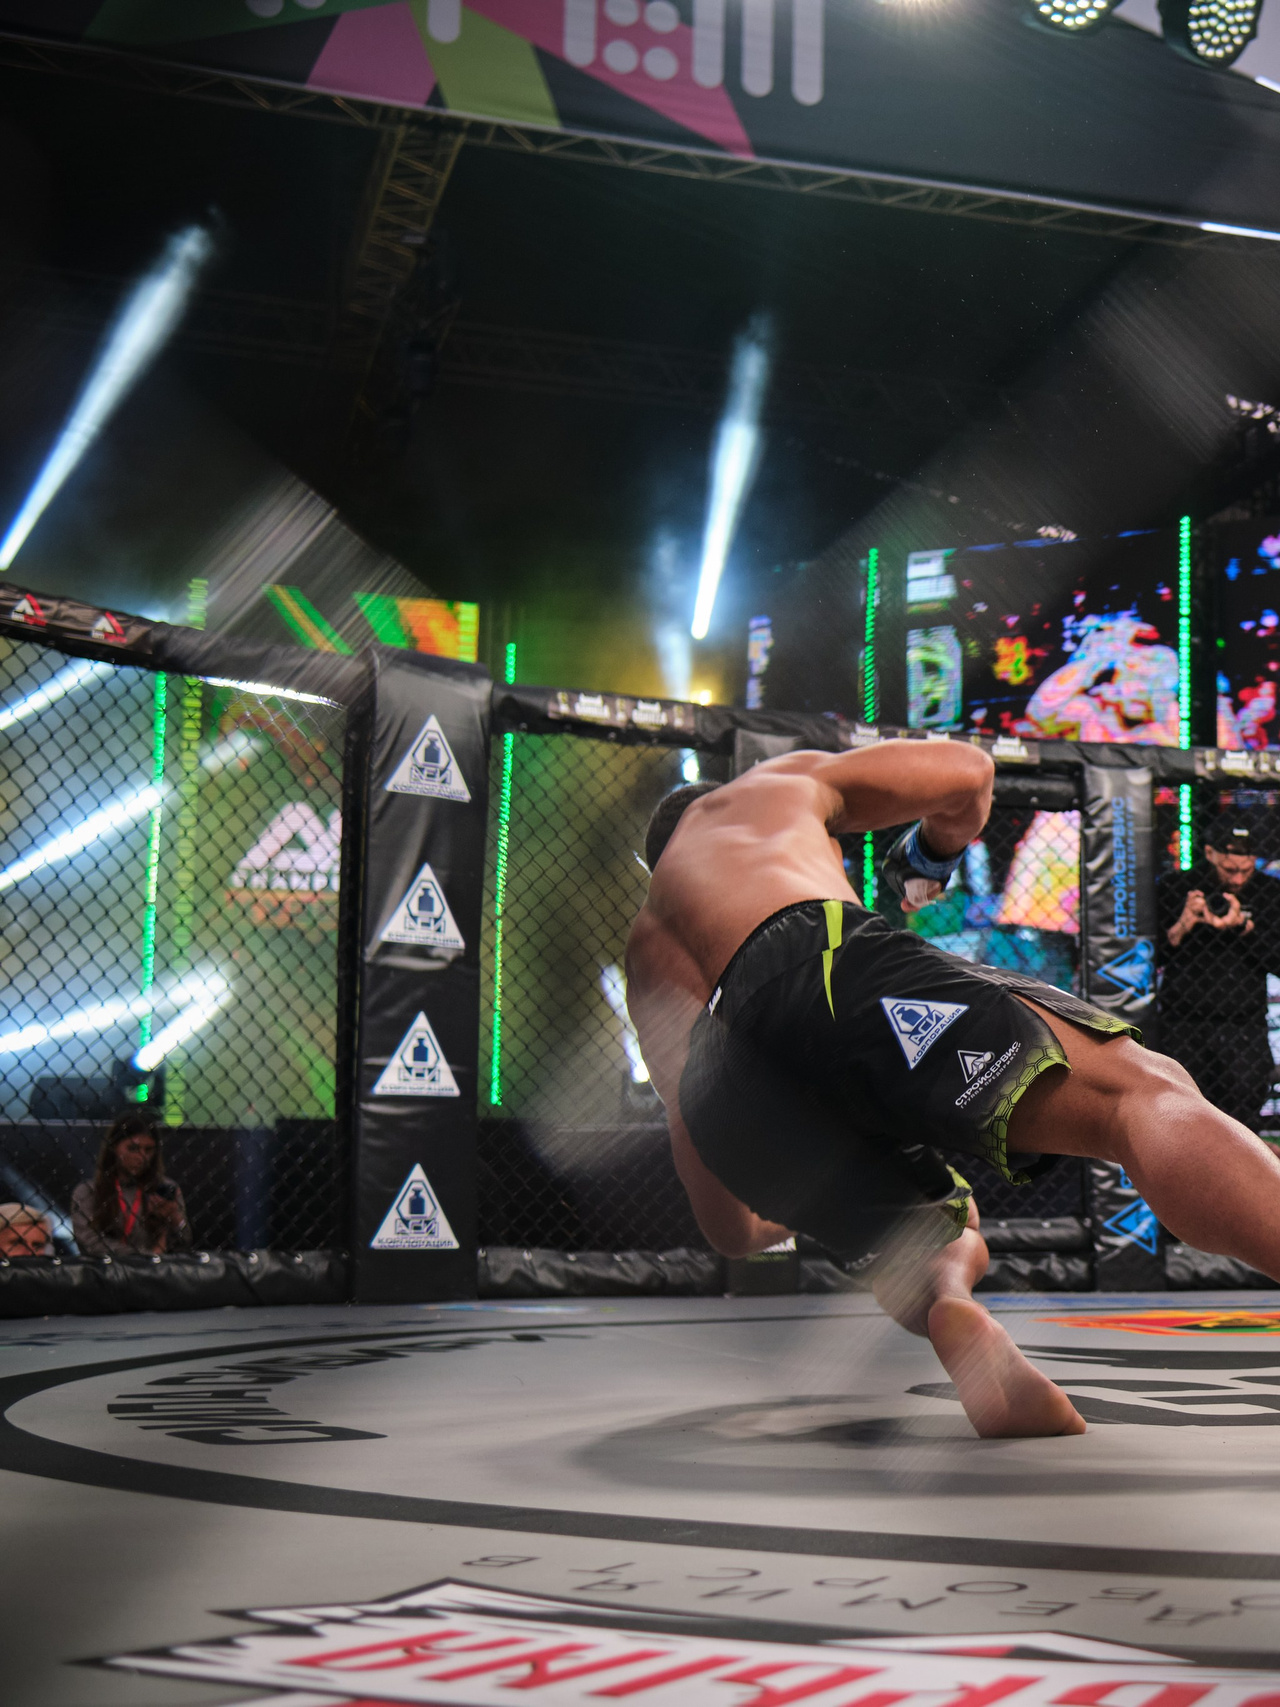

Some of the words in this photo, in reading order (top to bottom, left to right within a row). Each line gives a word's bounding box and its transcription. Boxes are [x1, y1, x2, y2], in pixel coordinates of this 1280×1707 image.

[1111, 797, 1128, 939] СТРОЙСЕРВИС
[910, 1010, 945, 1046] АСИ
[912, 1007, 962, 1064] КОРПОРАЦИЯ
[955, 1041, 1019, 1106] СТРОЙСЕРВИС
[107, 1387, 389, 1446] СИЛА
